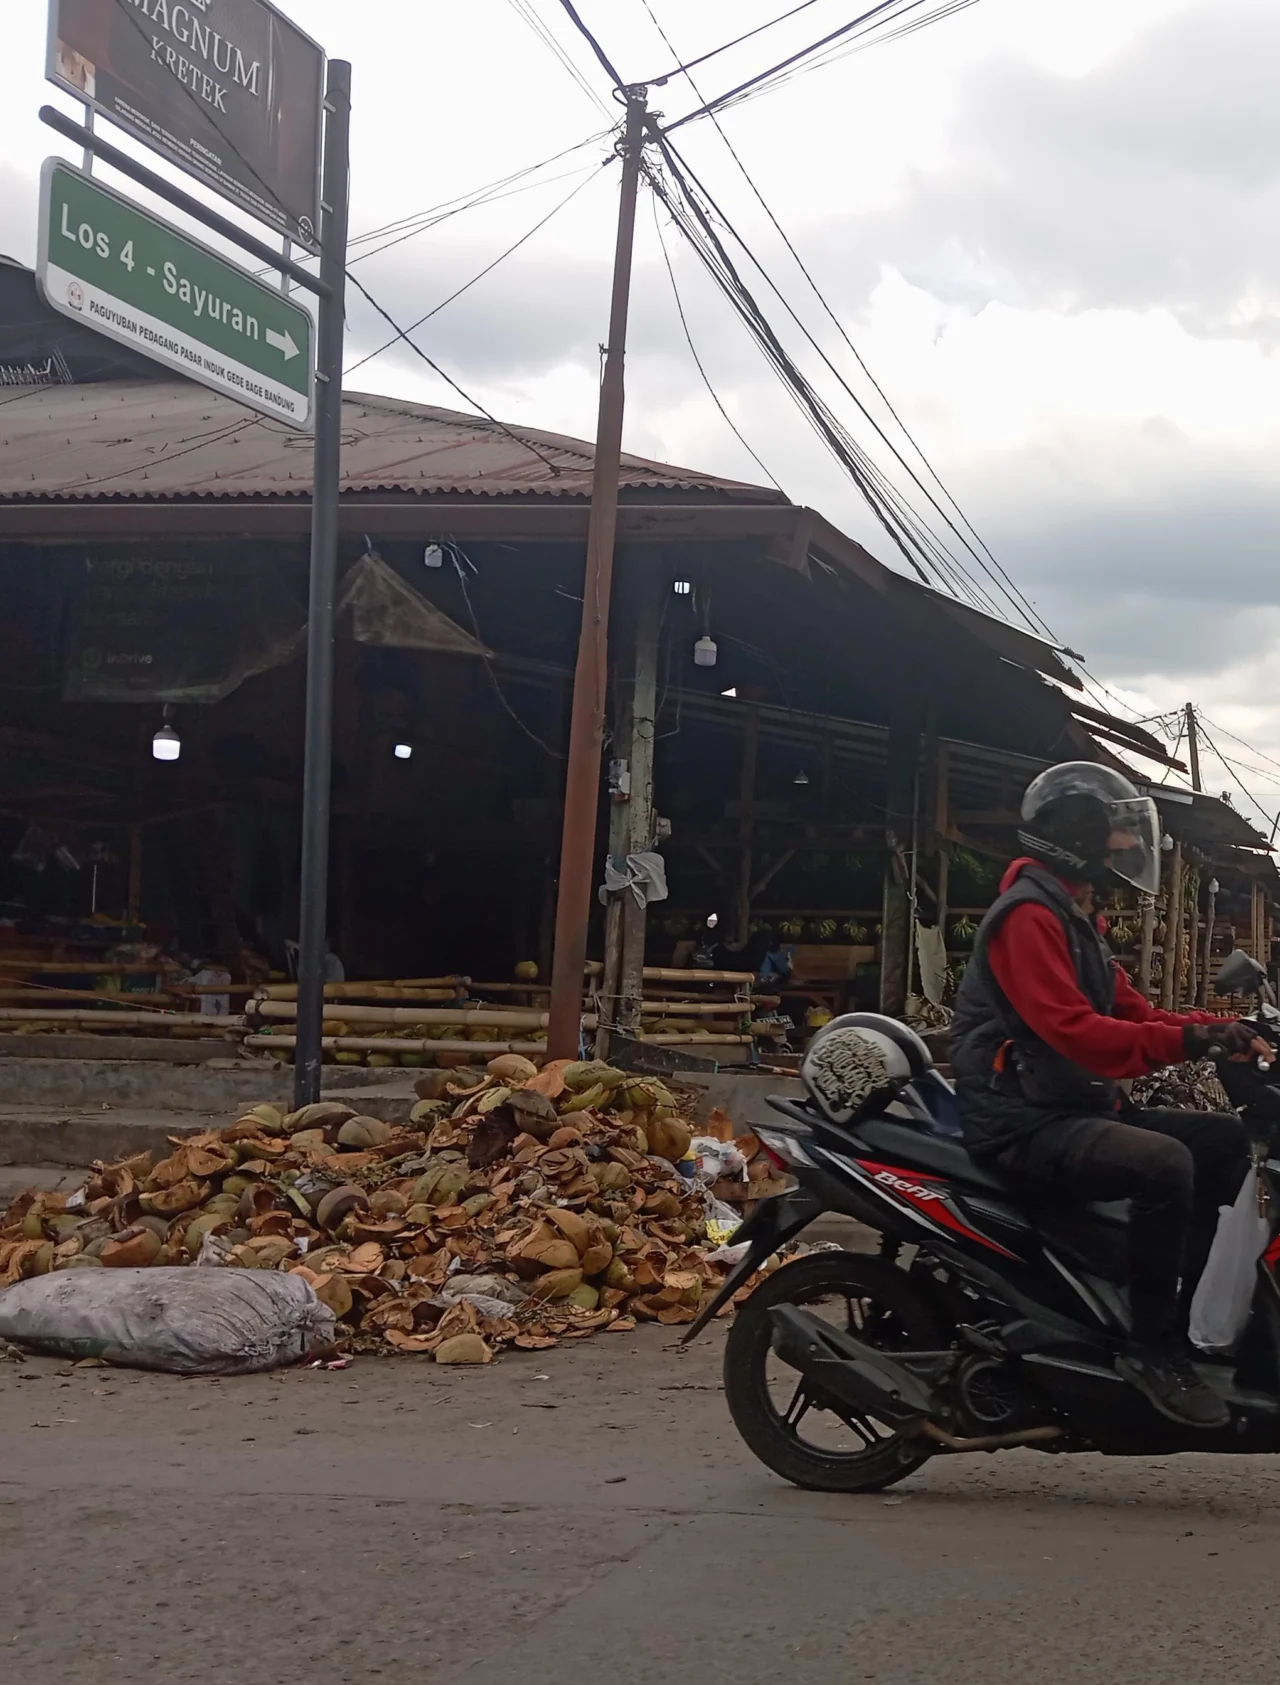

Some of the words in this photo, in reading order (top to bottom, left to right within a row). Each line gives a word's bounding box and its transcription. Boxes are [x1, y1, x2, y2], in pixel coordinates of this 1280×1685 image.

[150, 35, 228, 114] KRETEK
[61, 202, 110, 259] Los
[119, 240, 135, 272] 4
[146, 266, 156, 277] -
[162, 261, 259, 341] Sayuran
[89, 300, 138, 335] PAGUYUBAN
[138, 325, 179, 355] PEDAGANG
[180, 346, 203, 366] PASAR
[203, 358, 225, 379] INDUK
[227, 370, 244, 389] GEDE
[245, 380, 263, 398] BAGE
[264, 389, 295, 413] BANDUNG
